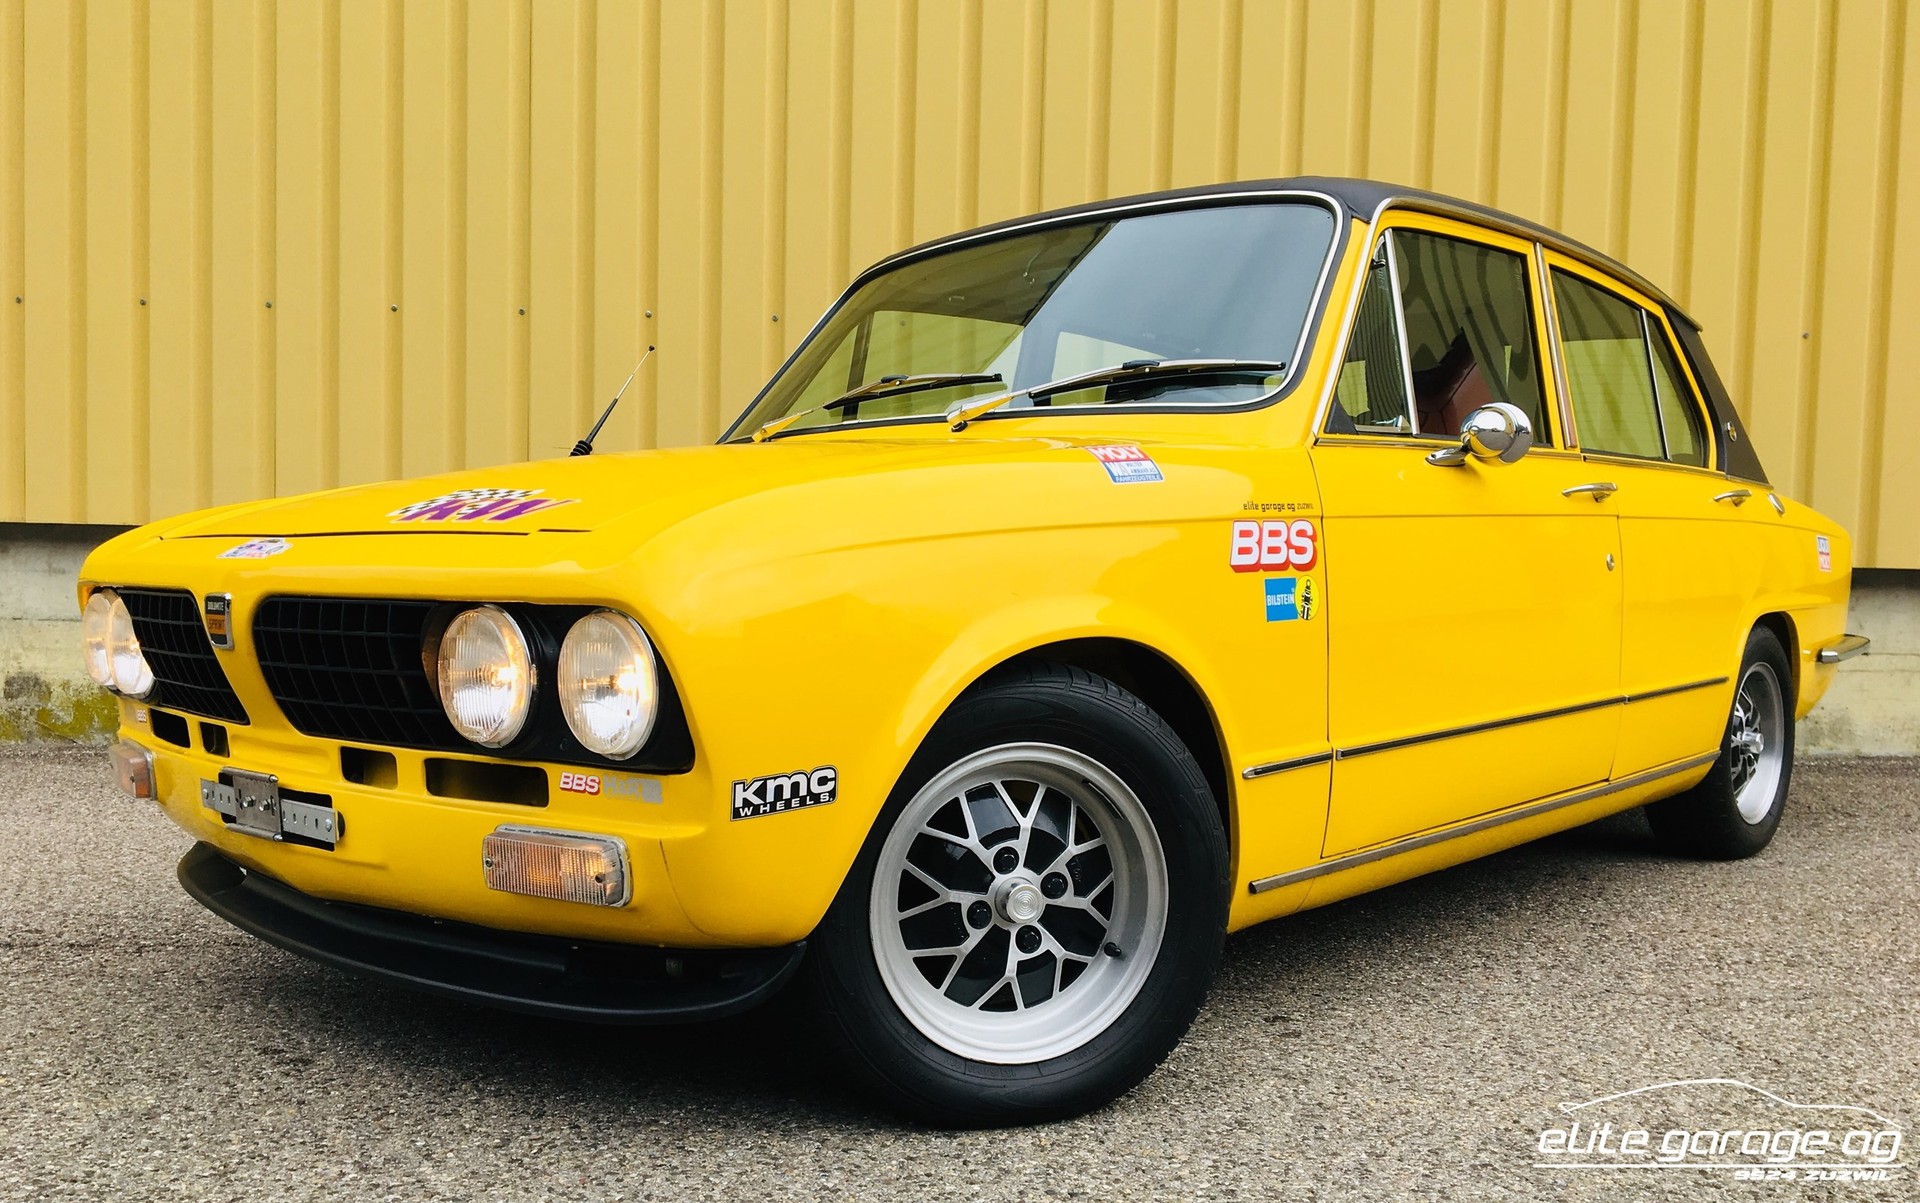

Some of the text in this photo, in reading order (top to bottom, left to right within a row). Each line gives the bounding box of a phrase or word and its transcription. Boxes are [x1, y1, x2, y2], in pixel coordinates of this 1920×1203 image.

[1243, 501, 1259, 510] elite
[1261, 503, 1285, 512] garage
[1287, 503, 1296, 512] ag
[1231, 520, 1316, 572] BBS
[1266, 593, 1295, 606] BILSTEIN
[560, 772, 600, 796] BBS
